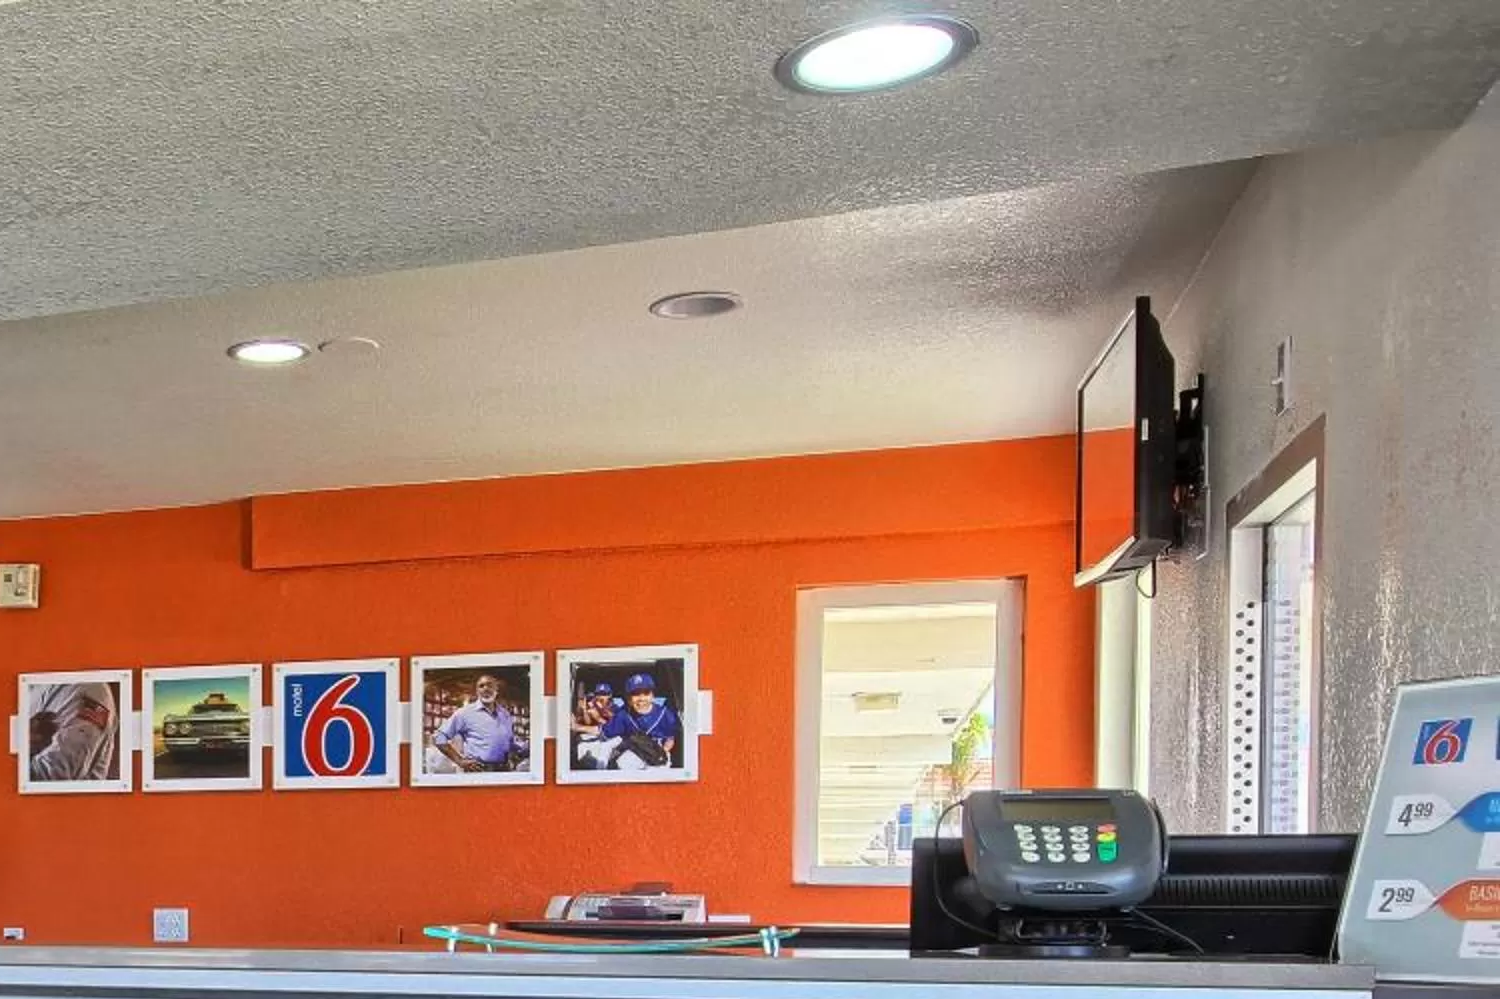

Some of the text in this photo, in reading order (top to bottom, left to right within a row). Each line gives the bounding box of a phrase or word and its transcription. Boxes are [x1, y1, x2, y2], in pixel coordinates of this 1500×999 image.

[291, 674, 375, 777] motel 6
[1423, 720, 1462, 764] 6
